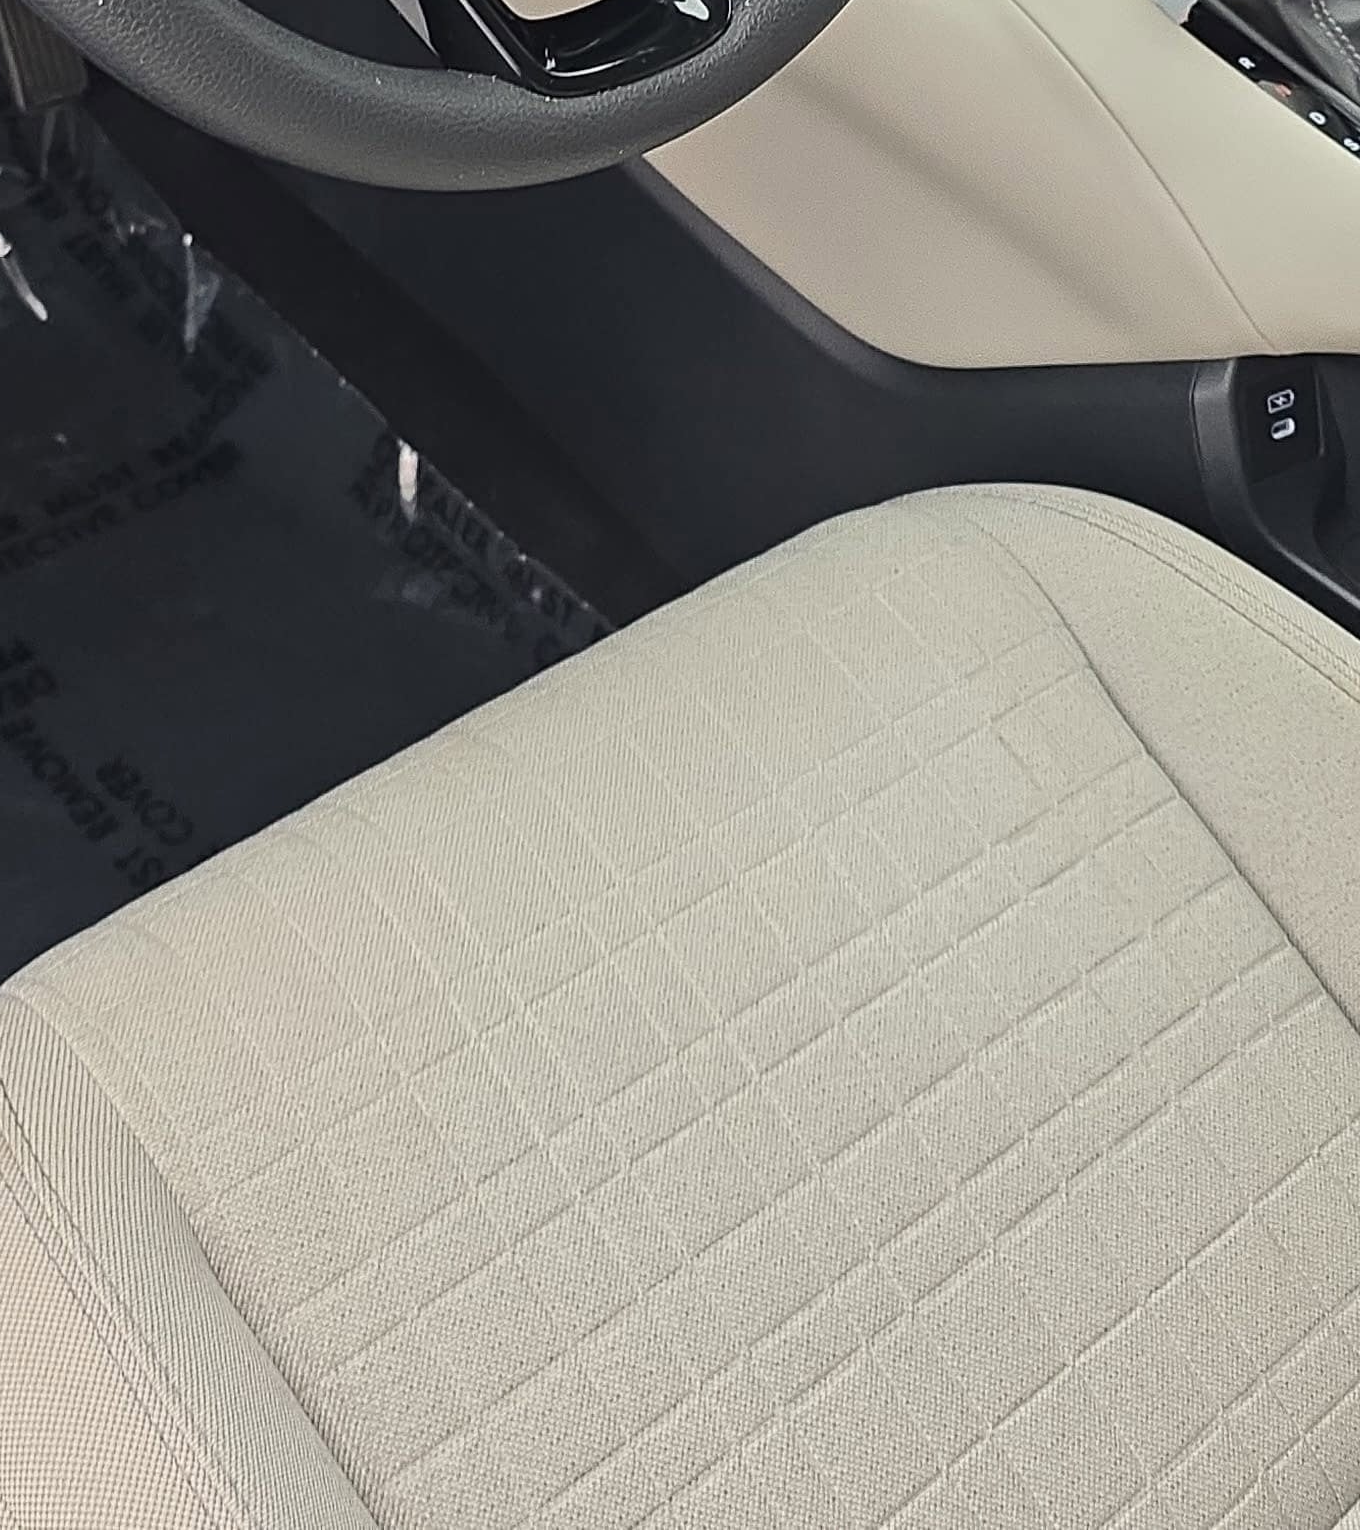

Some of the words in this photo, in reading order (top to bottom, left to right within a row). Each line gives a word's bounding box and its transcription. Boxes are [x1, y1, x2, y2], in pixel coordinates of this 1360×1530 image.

[1238, 56, 1256, 70] R
[1308, 111, 1326, 126] D
[1343, 137, 1360, 152] S
